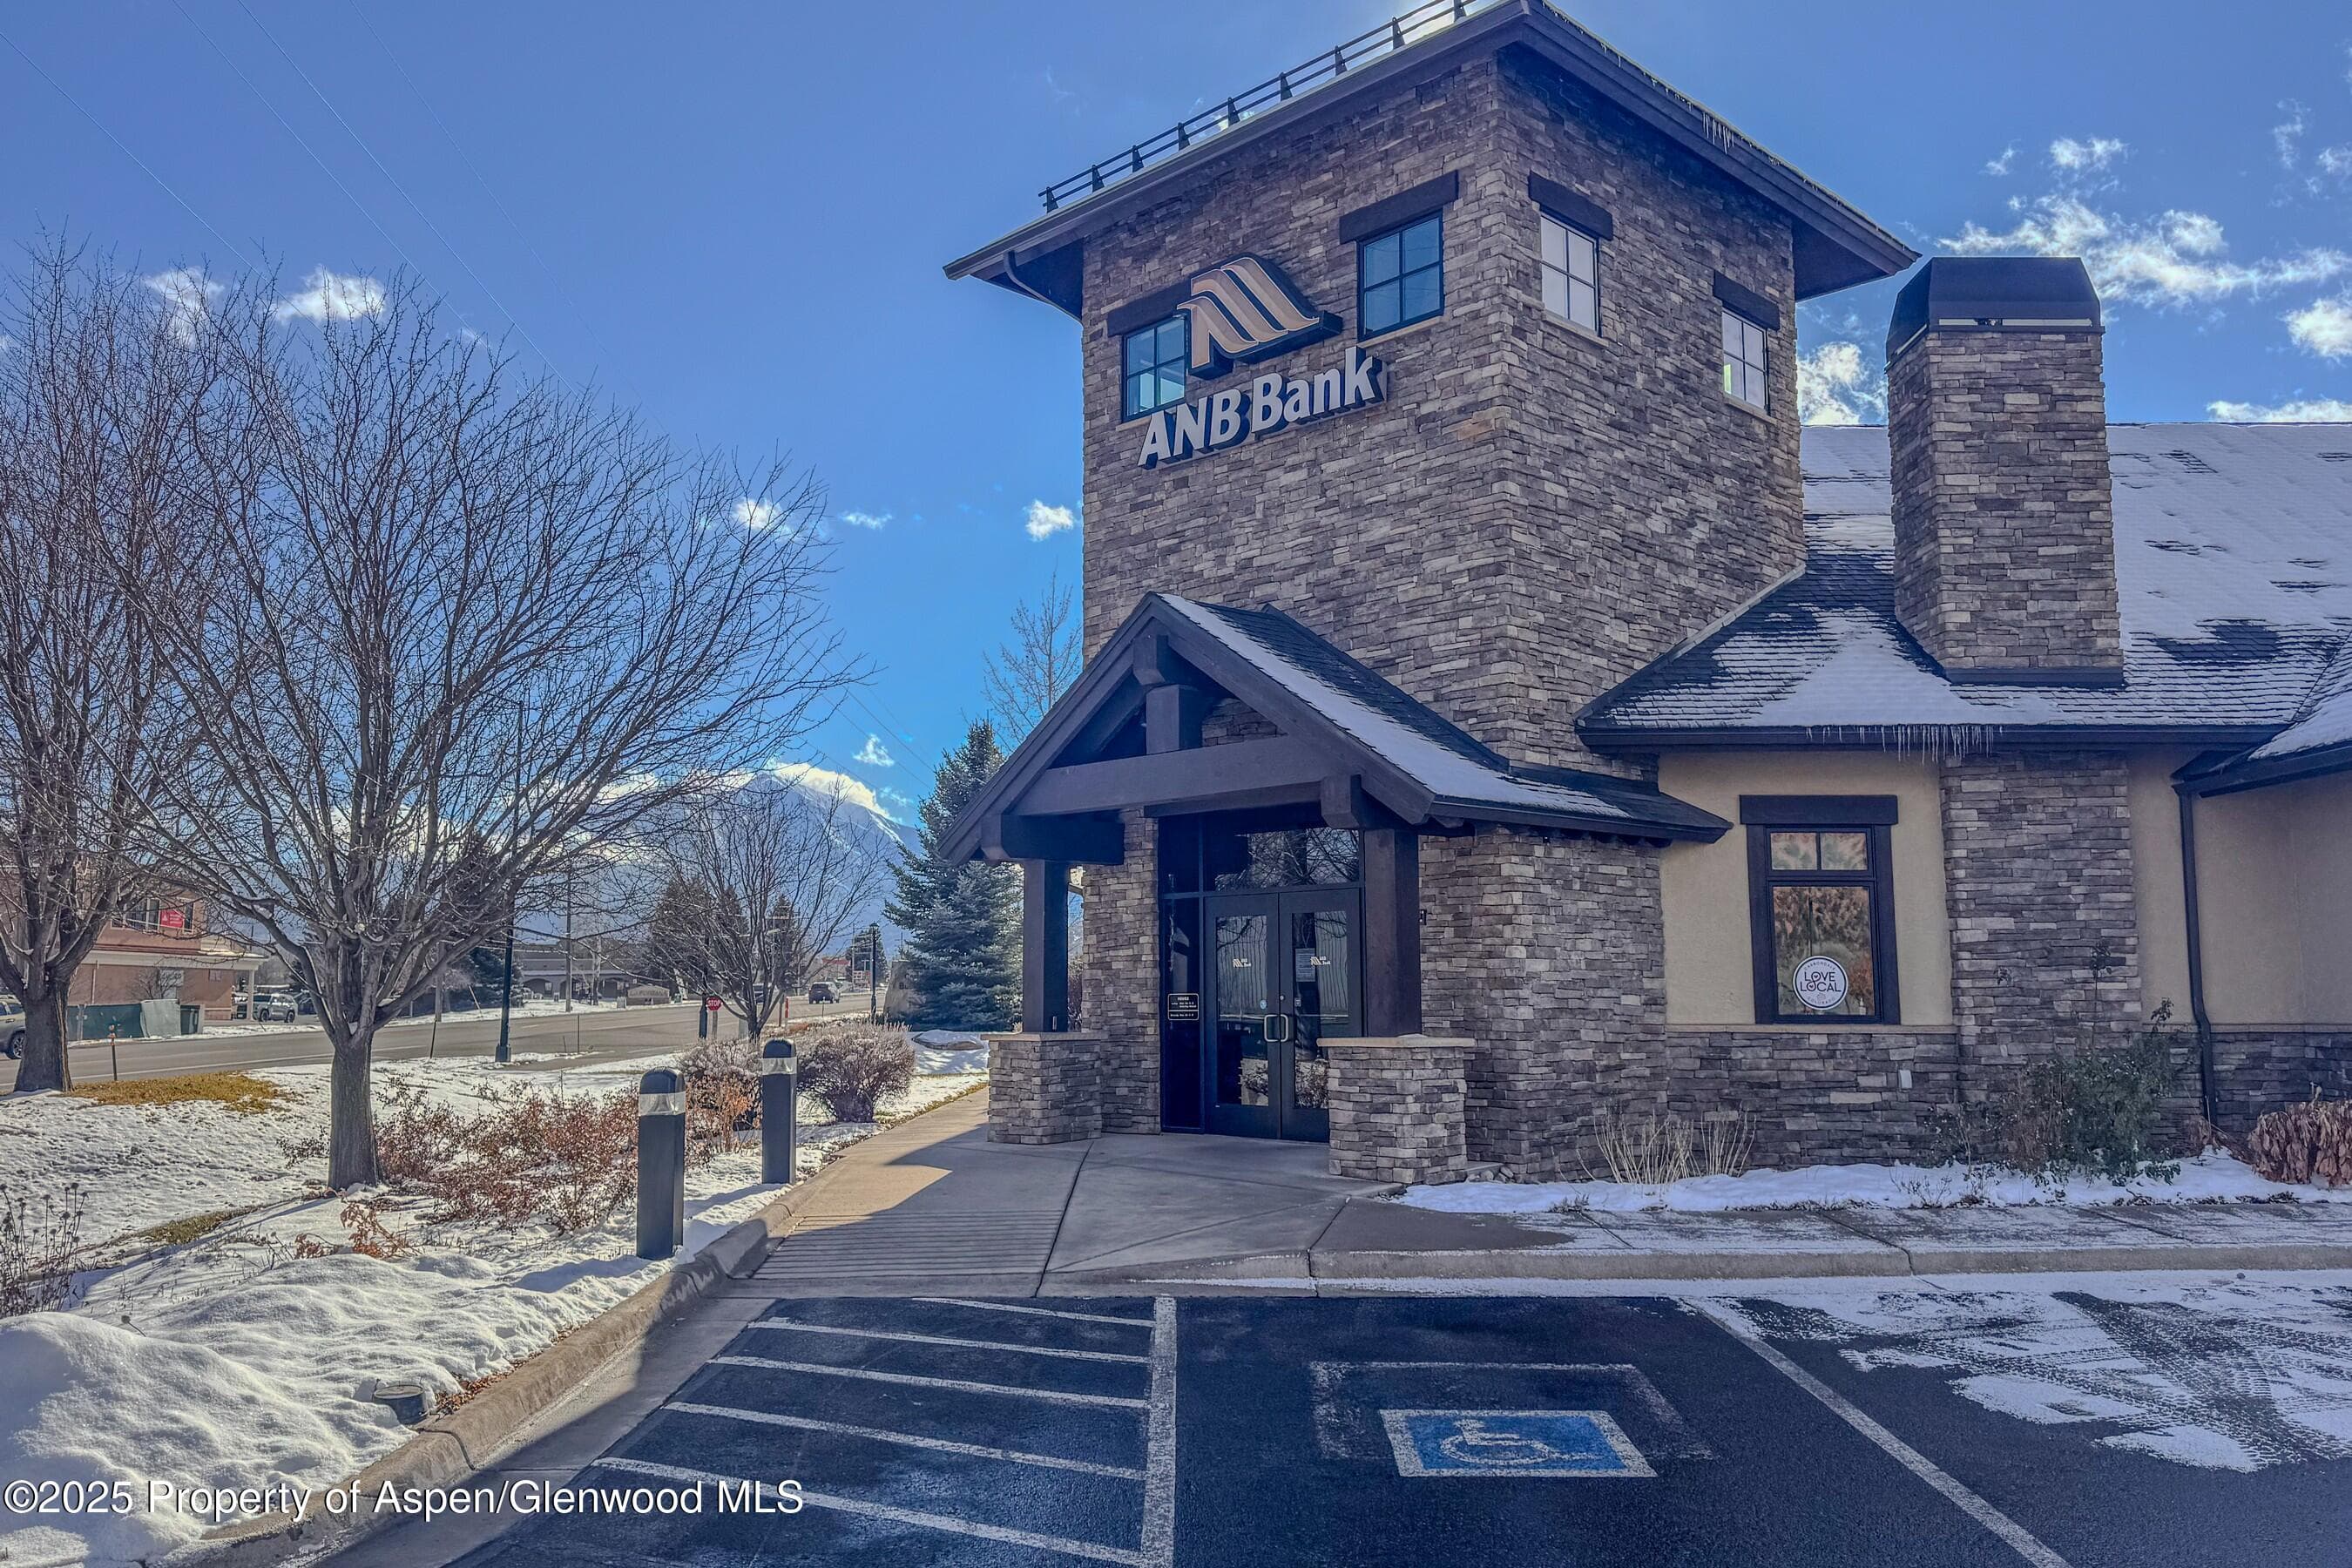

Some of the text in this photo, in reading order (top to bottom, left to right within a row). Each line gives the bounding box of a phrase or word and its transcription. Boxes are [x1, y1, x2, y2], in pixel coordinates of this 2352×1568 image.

[1137, 347, 1376, 466] ANB Bank
[1804, 971, 1835, 982] LOVE
[1800, 982, 1842, 992] LOCAL
